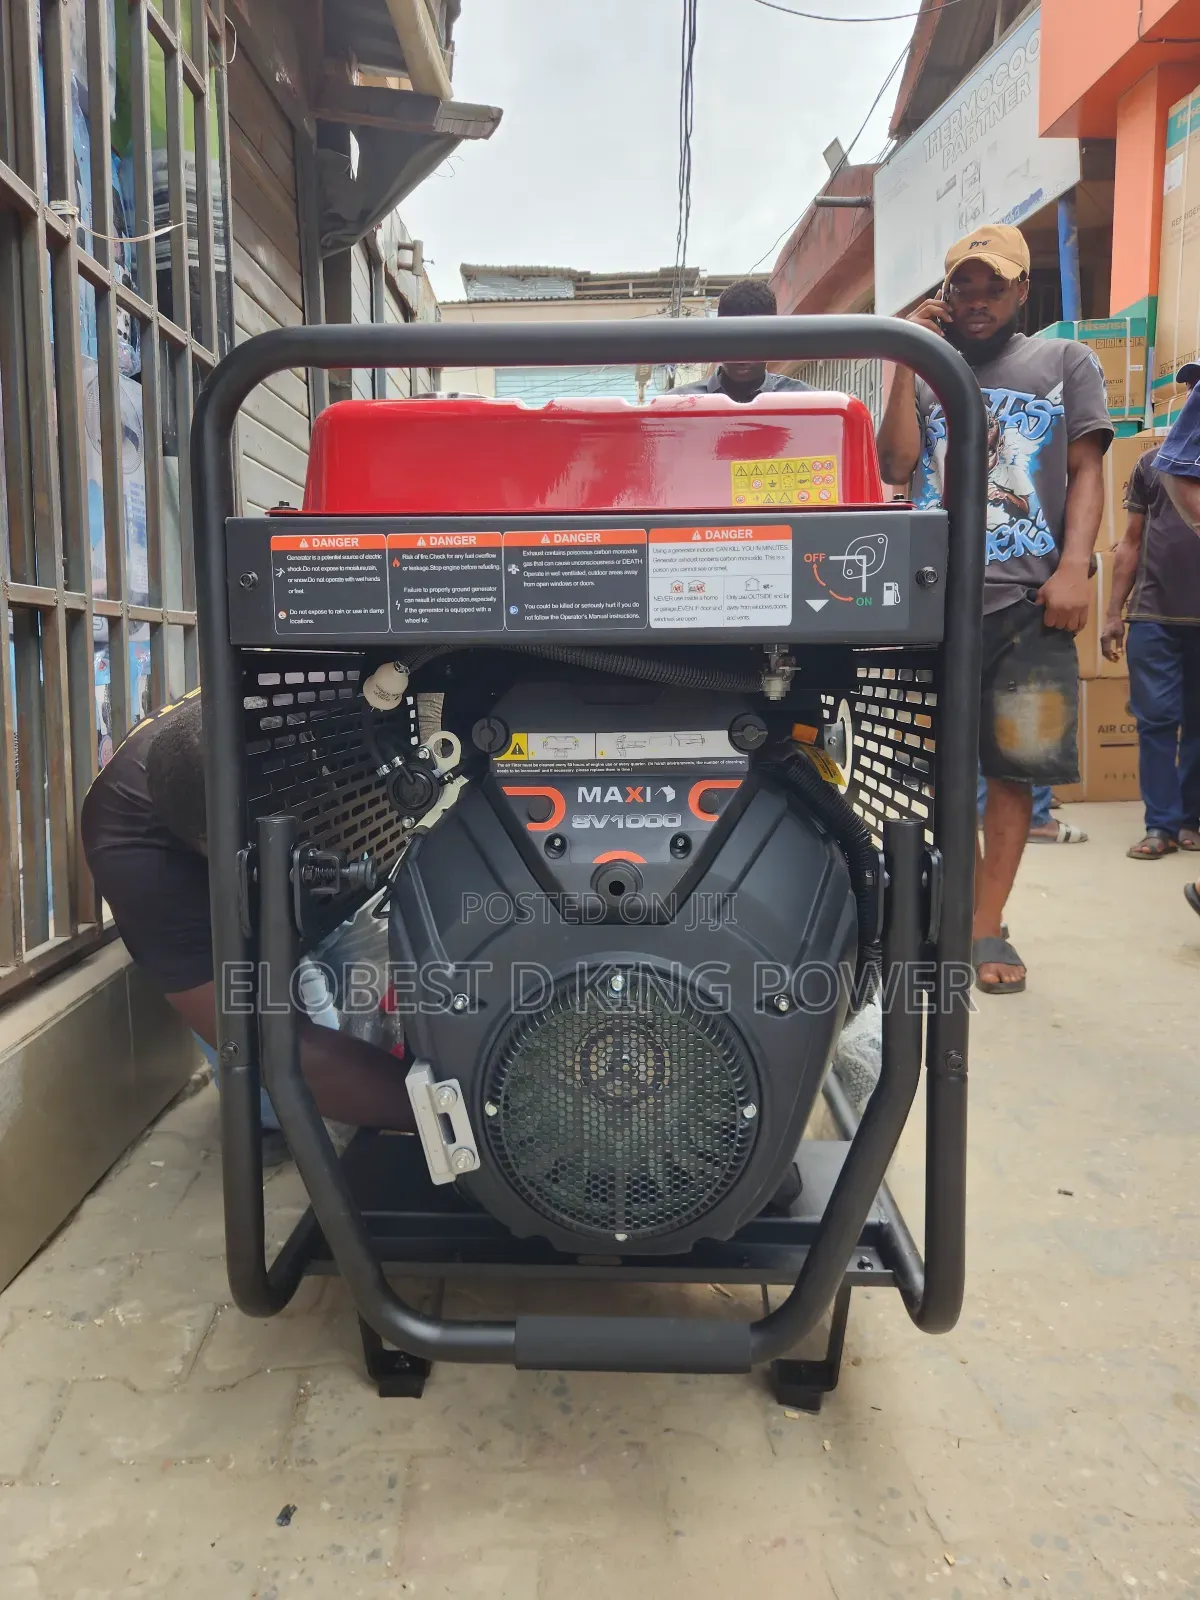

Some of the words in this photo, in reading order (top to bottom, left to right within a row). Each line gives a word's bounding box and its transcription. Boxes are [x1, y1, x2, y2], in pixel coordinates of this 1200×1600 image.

[943, 72, 1031, 171] PARTNER
[554, 532, 601, 544] DANGER
[706, 529, 753, 540] DANGER
[312, 538, 360, 548] DANGER
[430, 536, 476, 546] DANGER
[804, 553, 826, 562] OFF
[856, 597, 872, 606] ON
[1098, 724, 1116, 734] AIR
[578, 786, 651, 803] MAXI
[572, 814, 682, 828] SV1000
